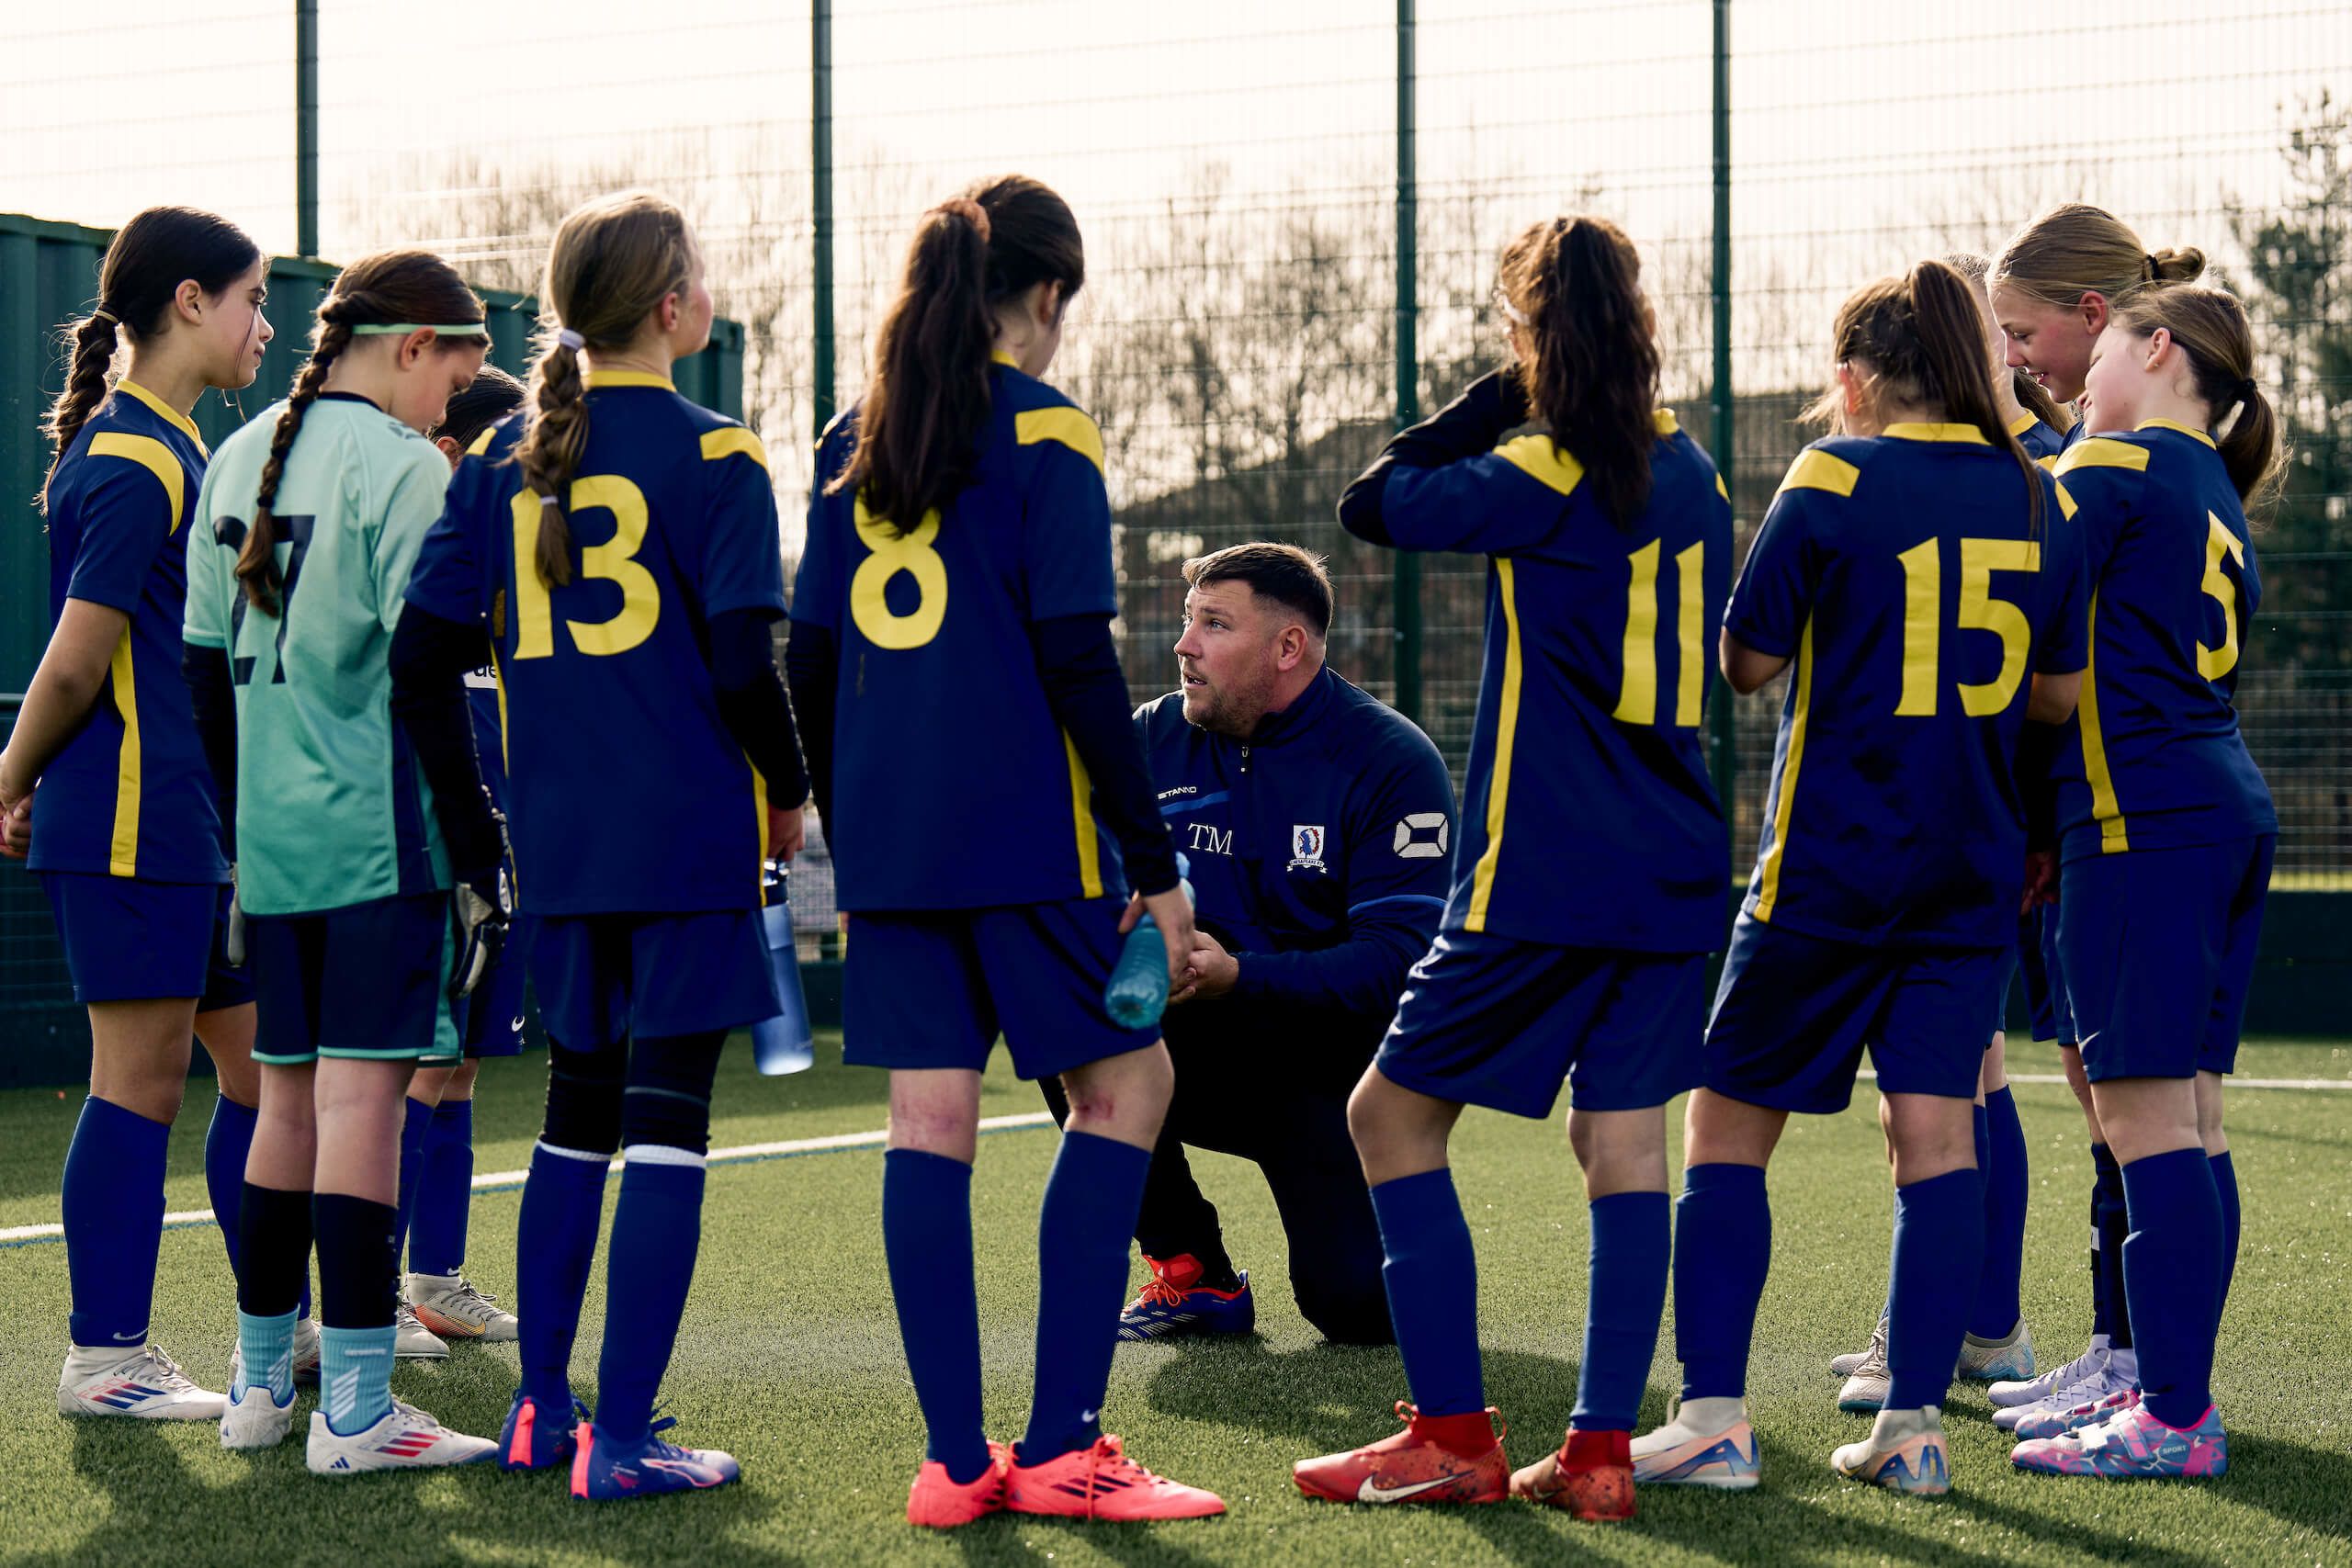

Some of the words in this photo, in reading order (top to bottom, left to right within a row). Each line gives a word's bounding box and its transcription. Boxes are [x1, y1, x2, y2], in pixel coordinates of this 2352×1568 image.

[213, 514, 316, 685] 27
[511, 474, 662, 660] 13
[850, 491, 948, 650] 8
[1614, 538, 1704, 727] 11
[1894, 537, 2041, 716] 15
[2196, 510, 2245, 683] 5
[1157, 786, 1197, 800] STANNO
[1186, 822, 1234, 856] TM
[2162, 1444, 2187, 1455] SPORT
